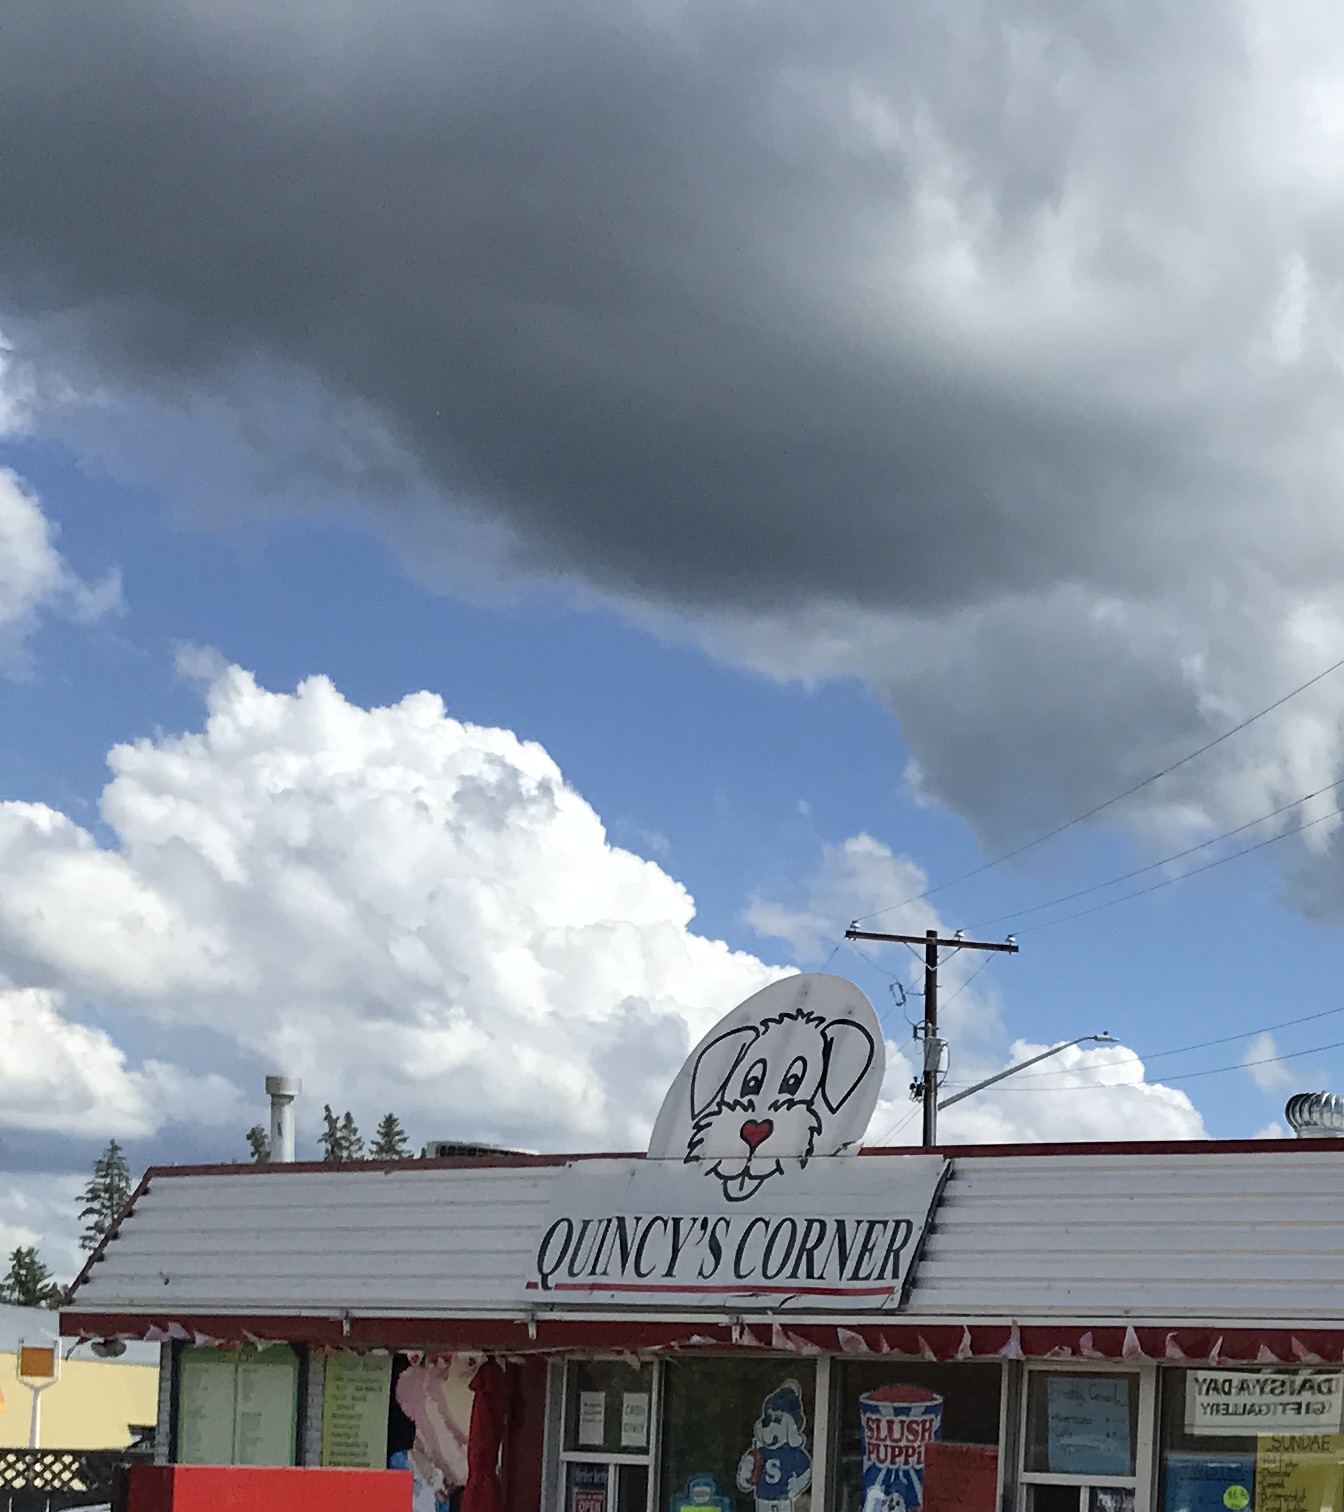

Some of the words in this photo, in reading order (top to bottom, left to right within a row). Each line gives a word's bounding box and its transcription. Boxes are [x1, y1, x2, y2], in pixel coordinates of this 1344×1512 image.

[536, 1215, 730, 1290] QUINCY'S
[733, 1216, 914, 1281] CORNER
[866, 1416, 935, 1444] SLUSH
[765, 1458, 783, 1485] S
